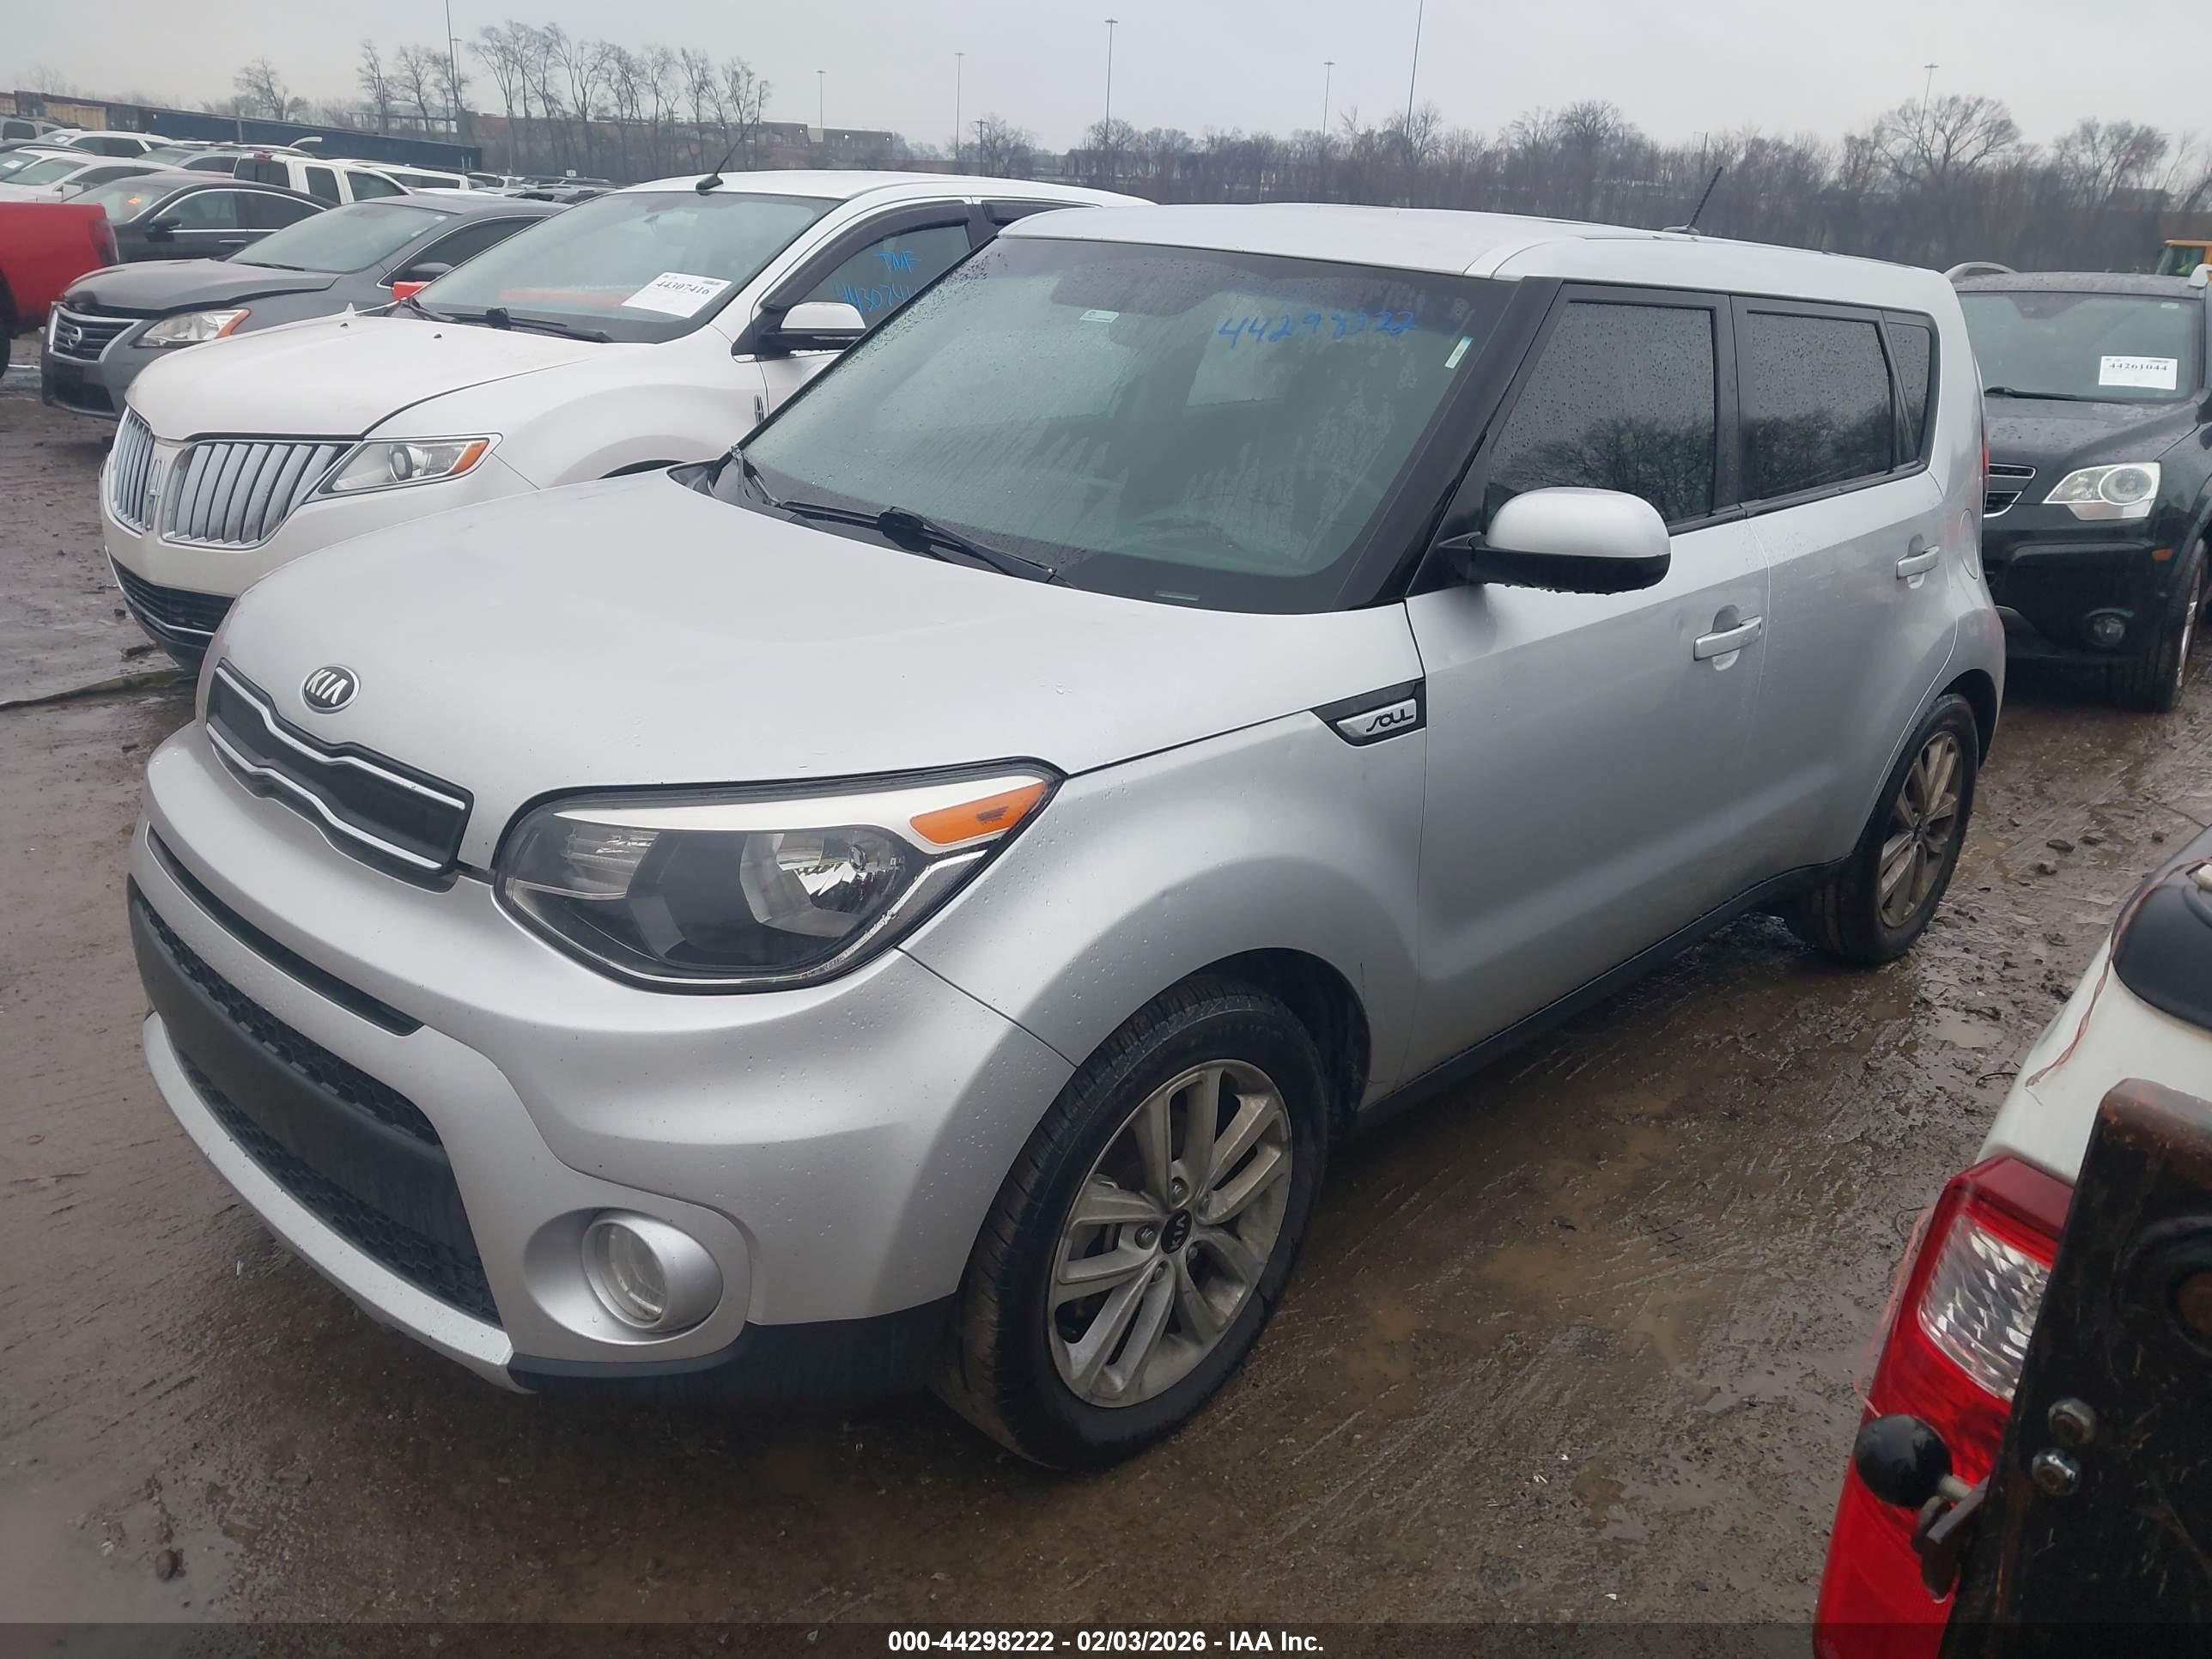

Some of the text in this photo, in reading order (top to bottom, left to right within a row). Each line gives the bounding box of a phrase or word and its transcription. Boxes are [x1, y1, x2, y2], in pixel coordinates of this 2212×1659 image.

[657, 280, 710, 295] 44307416
[2109, 362, 2167, 371] 44261044
[305, 669, 348, 705] KIA
[1365, 708, 1414, 732] SOUL
[1170, 1214, 1186, 1250] KIA
